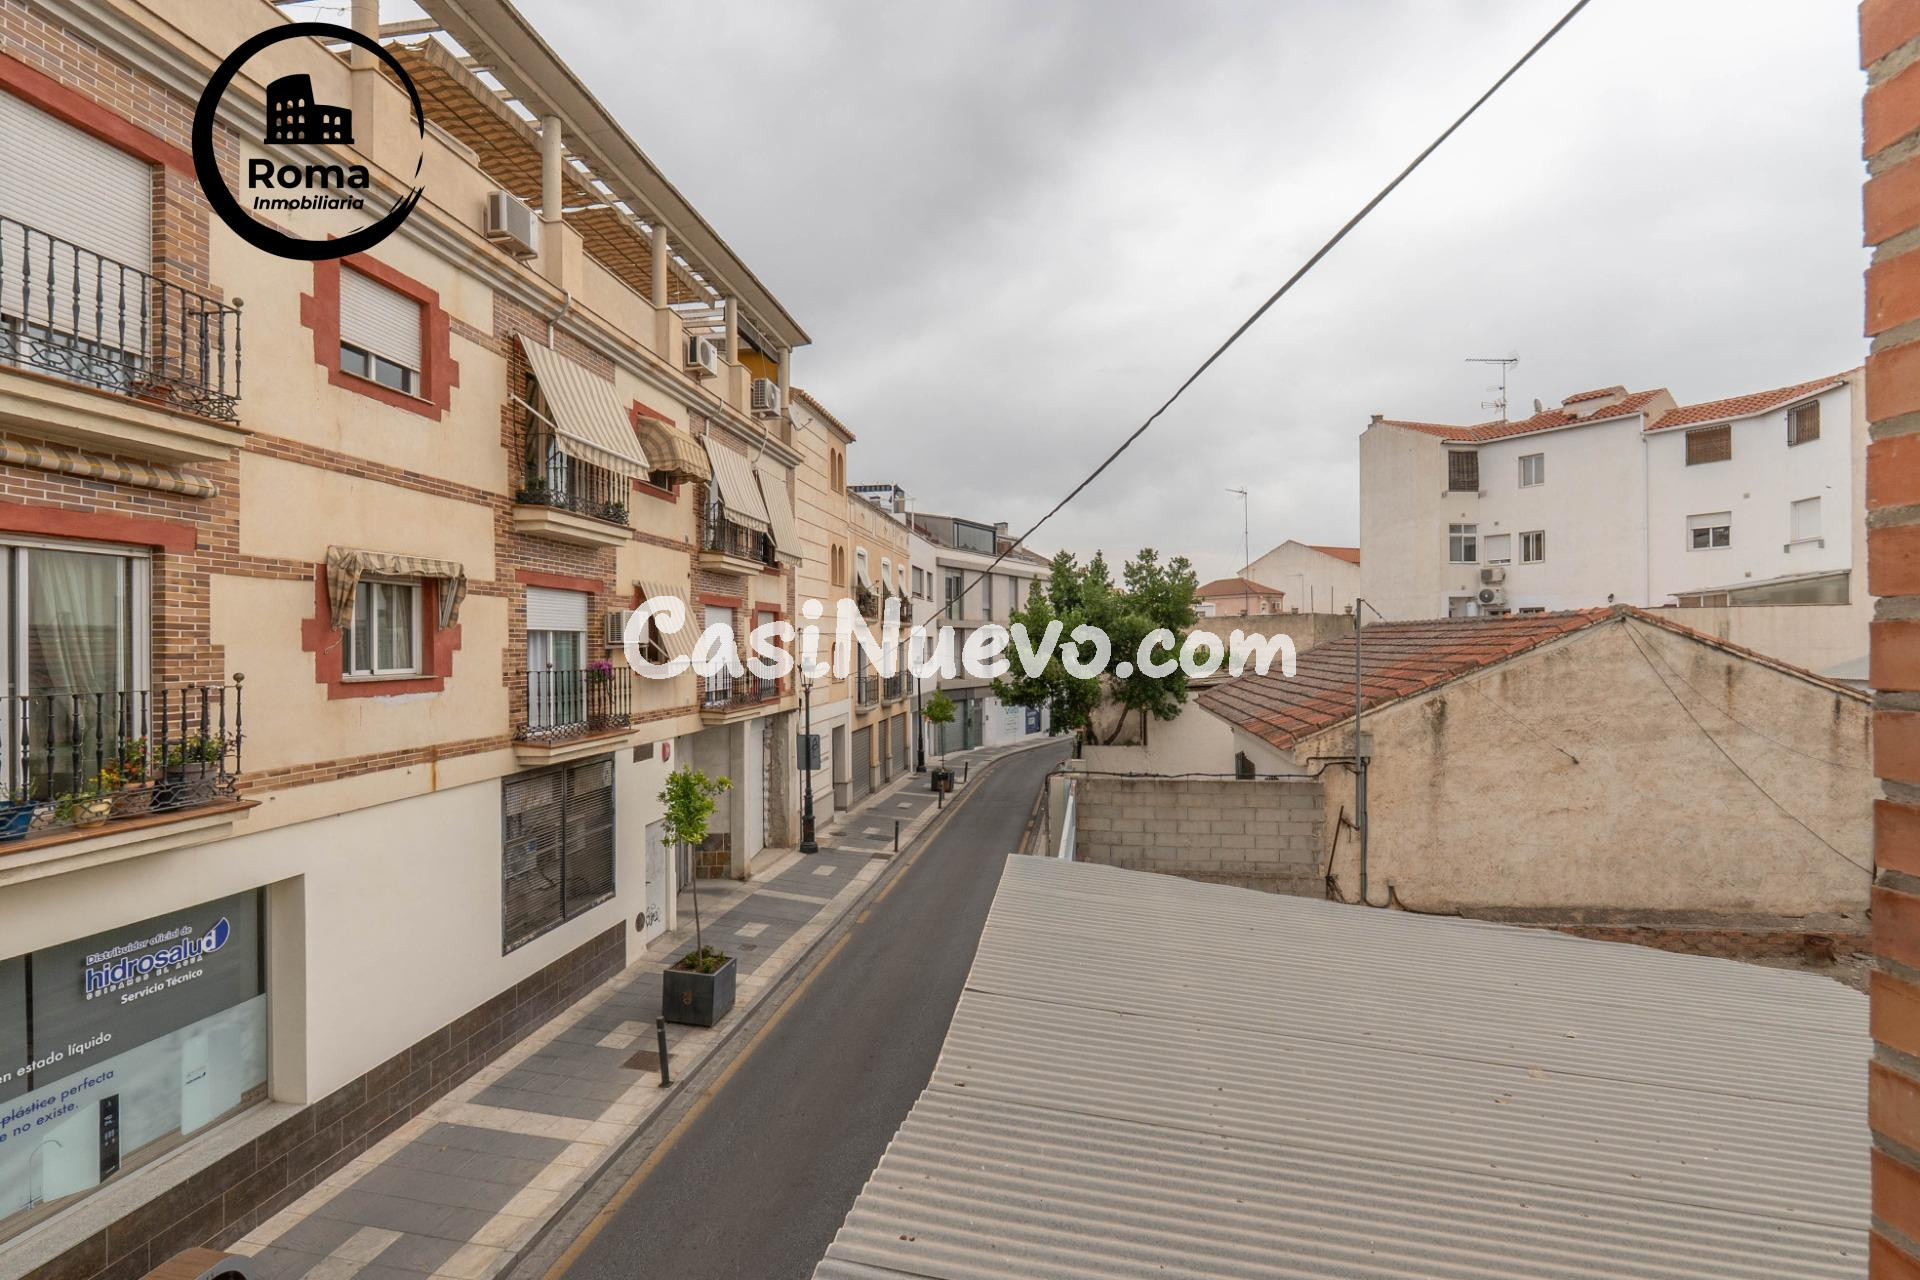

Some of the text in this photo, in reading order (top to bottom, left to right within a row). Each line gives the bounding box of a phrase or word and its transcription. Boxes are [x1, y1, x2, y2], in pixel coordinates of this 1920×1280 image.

[85, 928, 218, 993] hidrosalud
[86, 926, 193, 966] Distribuidor oficial de
[120, 968, 203, 1005] Servicio Técnico
[0, 1032, 112, 1084] n estado líquido
[0, 1070, 114, 1128] plástico perfecta
[13, 1123, 31, 1137] no
[36, 1102, 78, 1126] existe.
